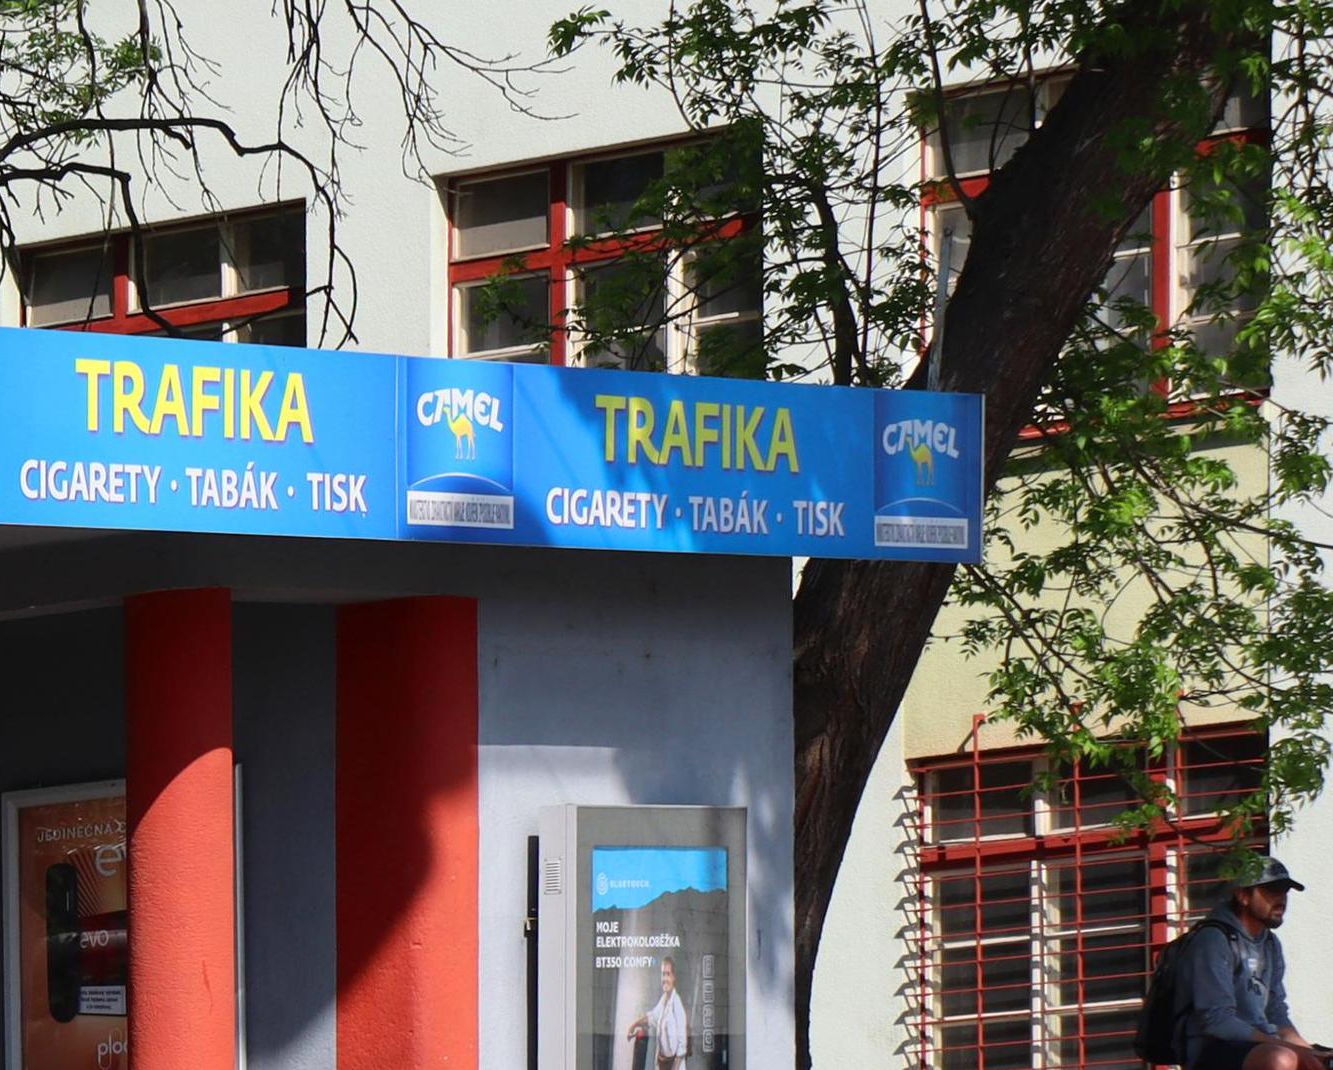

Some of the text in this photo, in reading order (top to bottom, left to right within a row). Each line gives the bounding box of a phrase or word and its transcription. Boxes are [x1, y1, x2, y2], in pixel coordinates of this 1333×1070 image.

[75, 358, 315, 444] TRAFIKA
[416, 387, 504, 433] CAMEL
[595, 394, 801, 473] TRAFIKA
[882, 418, 960, 460] CAMEL
[20, 458, 162, 504] CIGARETY
[185, 461, 279, 511] TABÁK
[306, 471, 368, 514] TISK
[545, 486, 669, 530] CIGARETY
[688, 490, 769, 535] TABÁK
[793, 500, 846, 537] TISK
[79, 929, 110, 949] evo
[595, 921, 619, 933] MOJE
[595, 933, 681, 948] ELEKTROKOLOBĚŽKA
[97, 1033, 128, 1070] plo
